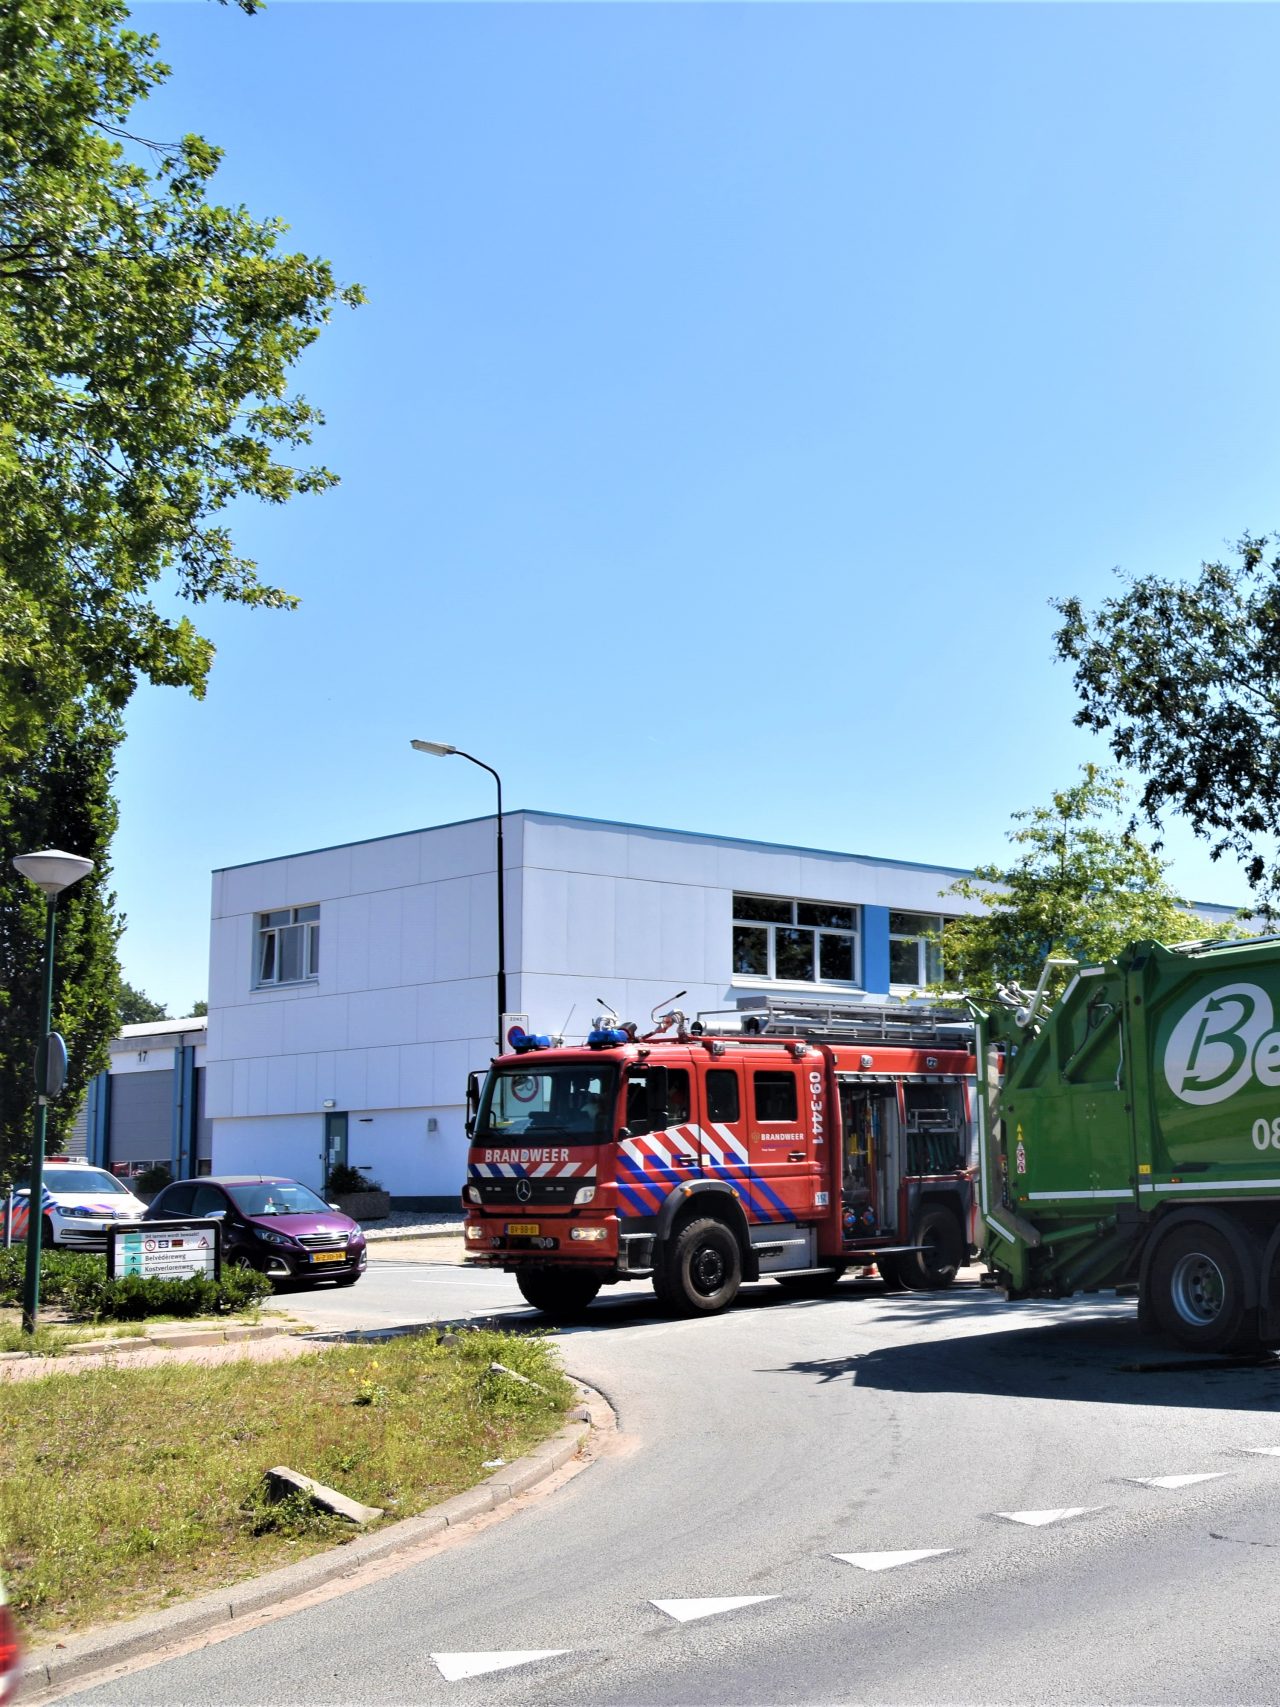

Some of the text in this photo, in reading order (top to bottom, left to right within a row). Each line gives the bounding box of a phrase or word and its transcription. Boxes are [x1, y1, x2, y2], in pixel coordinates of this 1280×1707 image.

[138, 1050, 148, 1063] 17
[809, 1071, 824, 1145] 09-3441
[761, 1133, 805, 1141] BRANDWEER
[485, 1149, 569, 1163] BRANDWEER
[145, 1264, 194, 1272] Kostverlorenweg
